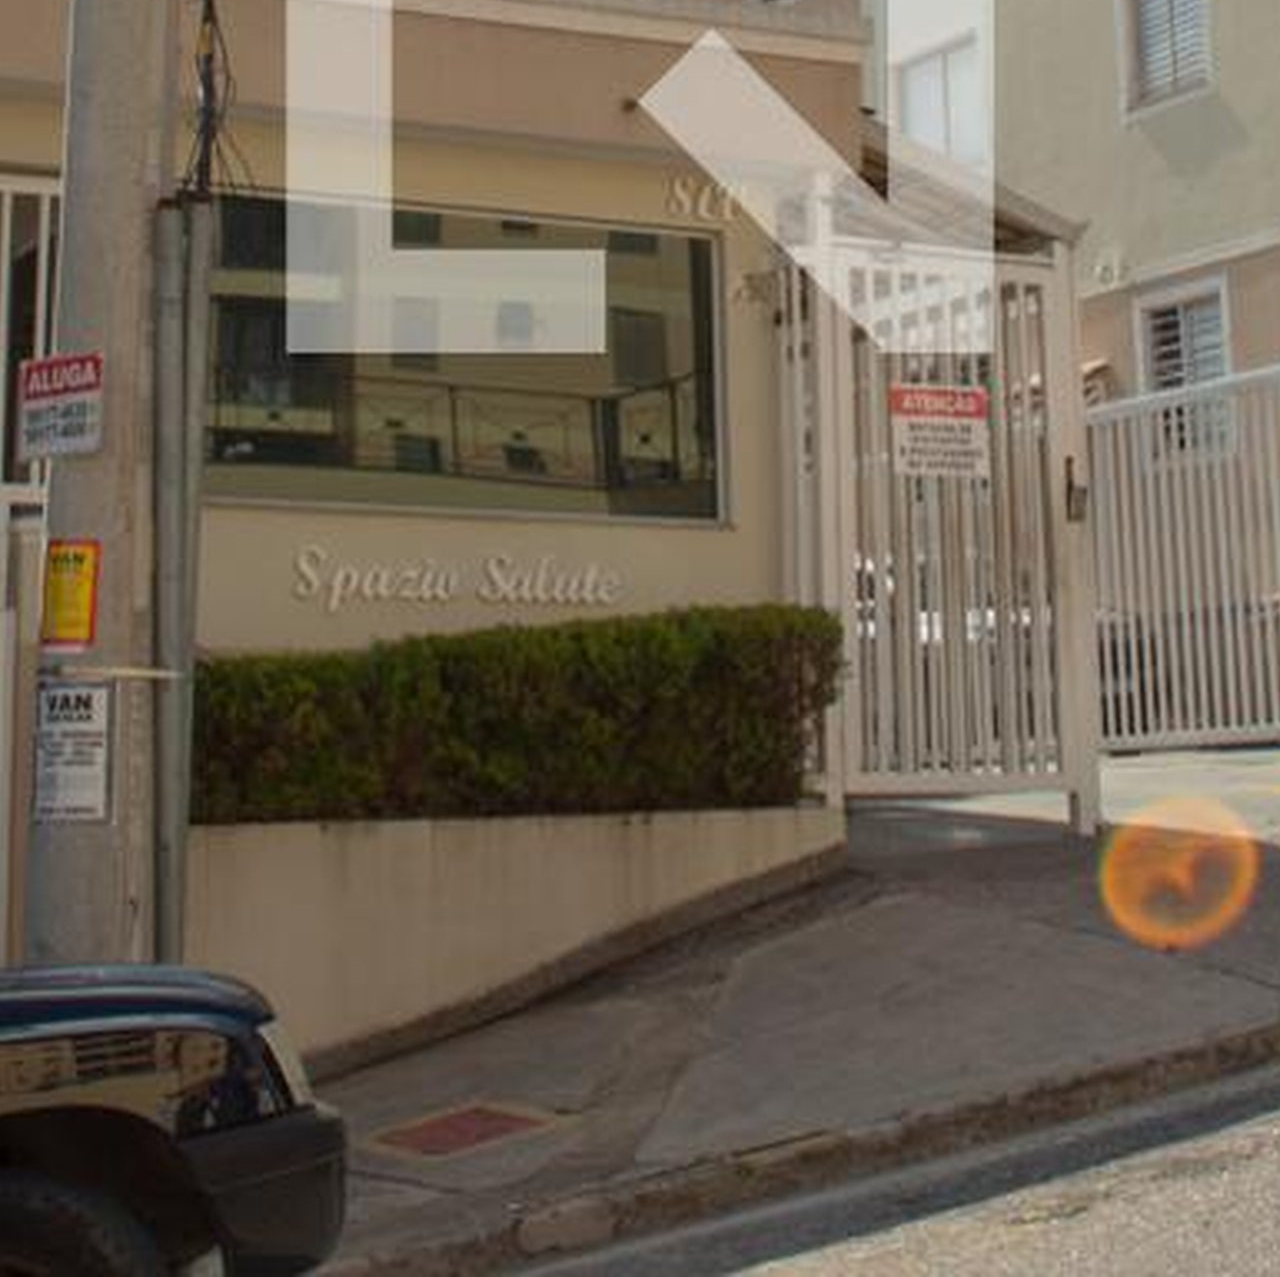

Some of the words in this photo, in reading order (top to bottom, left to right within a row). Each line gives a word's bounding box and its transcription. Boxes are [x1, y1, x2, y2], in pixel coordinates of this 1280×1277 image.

[28, 361, 98, 394] ALUGA
[476, 555, 621, 605] Salute
[47, 692, 94, 712] VAN
